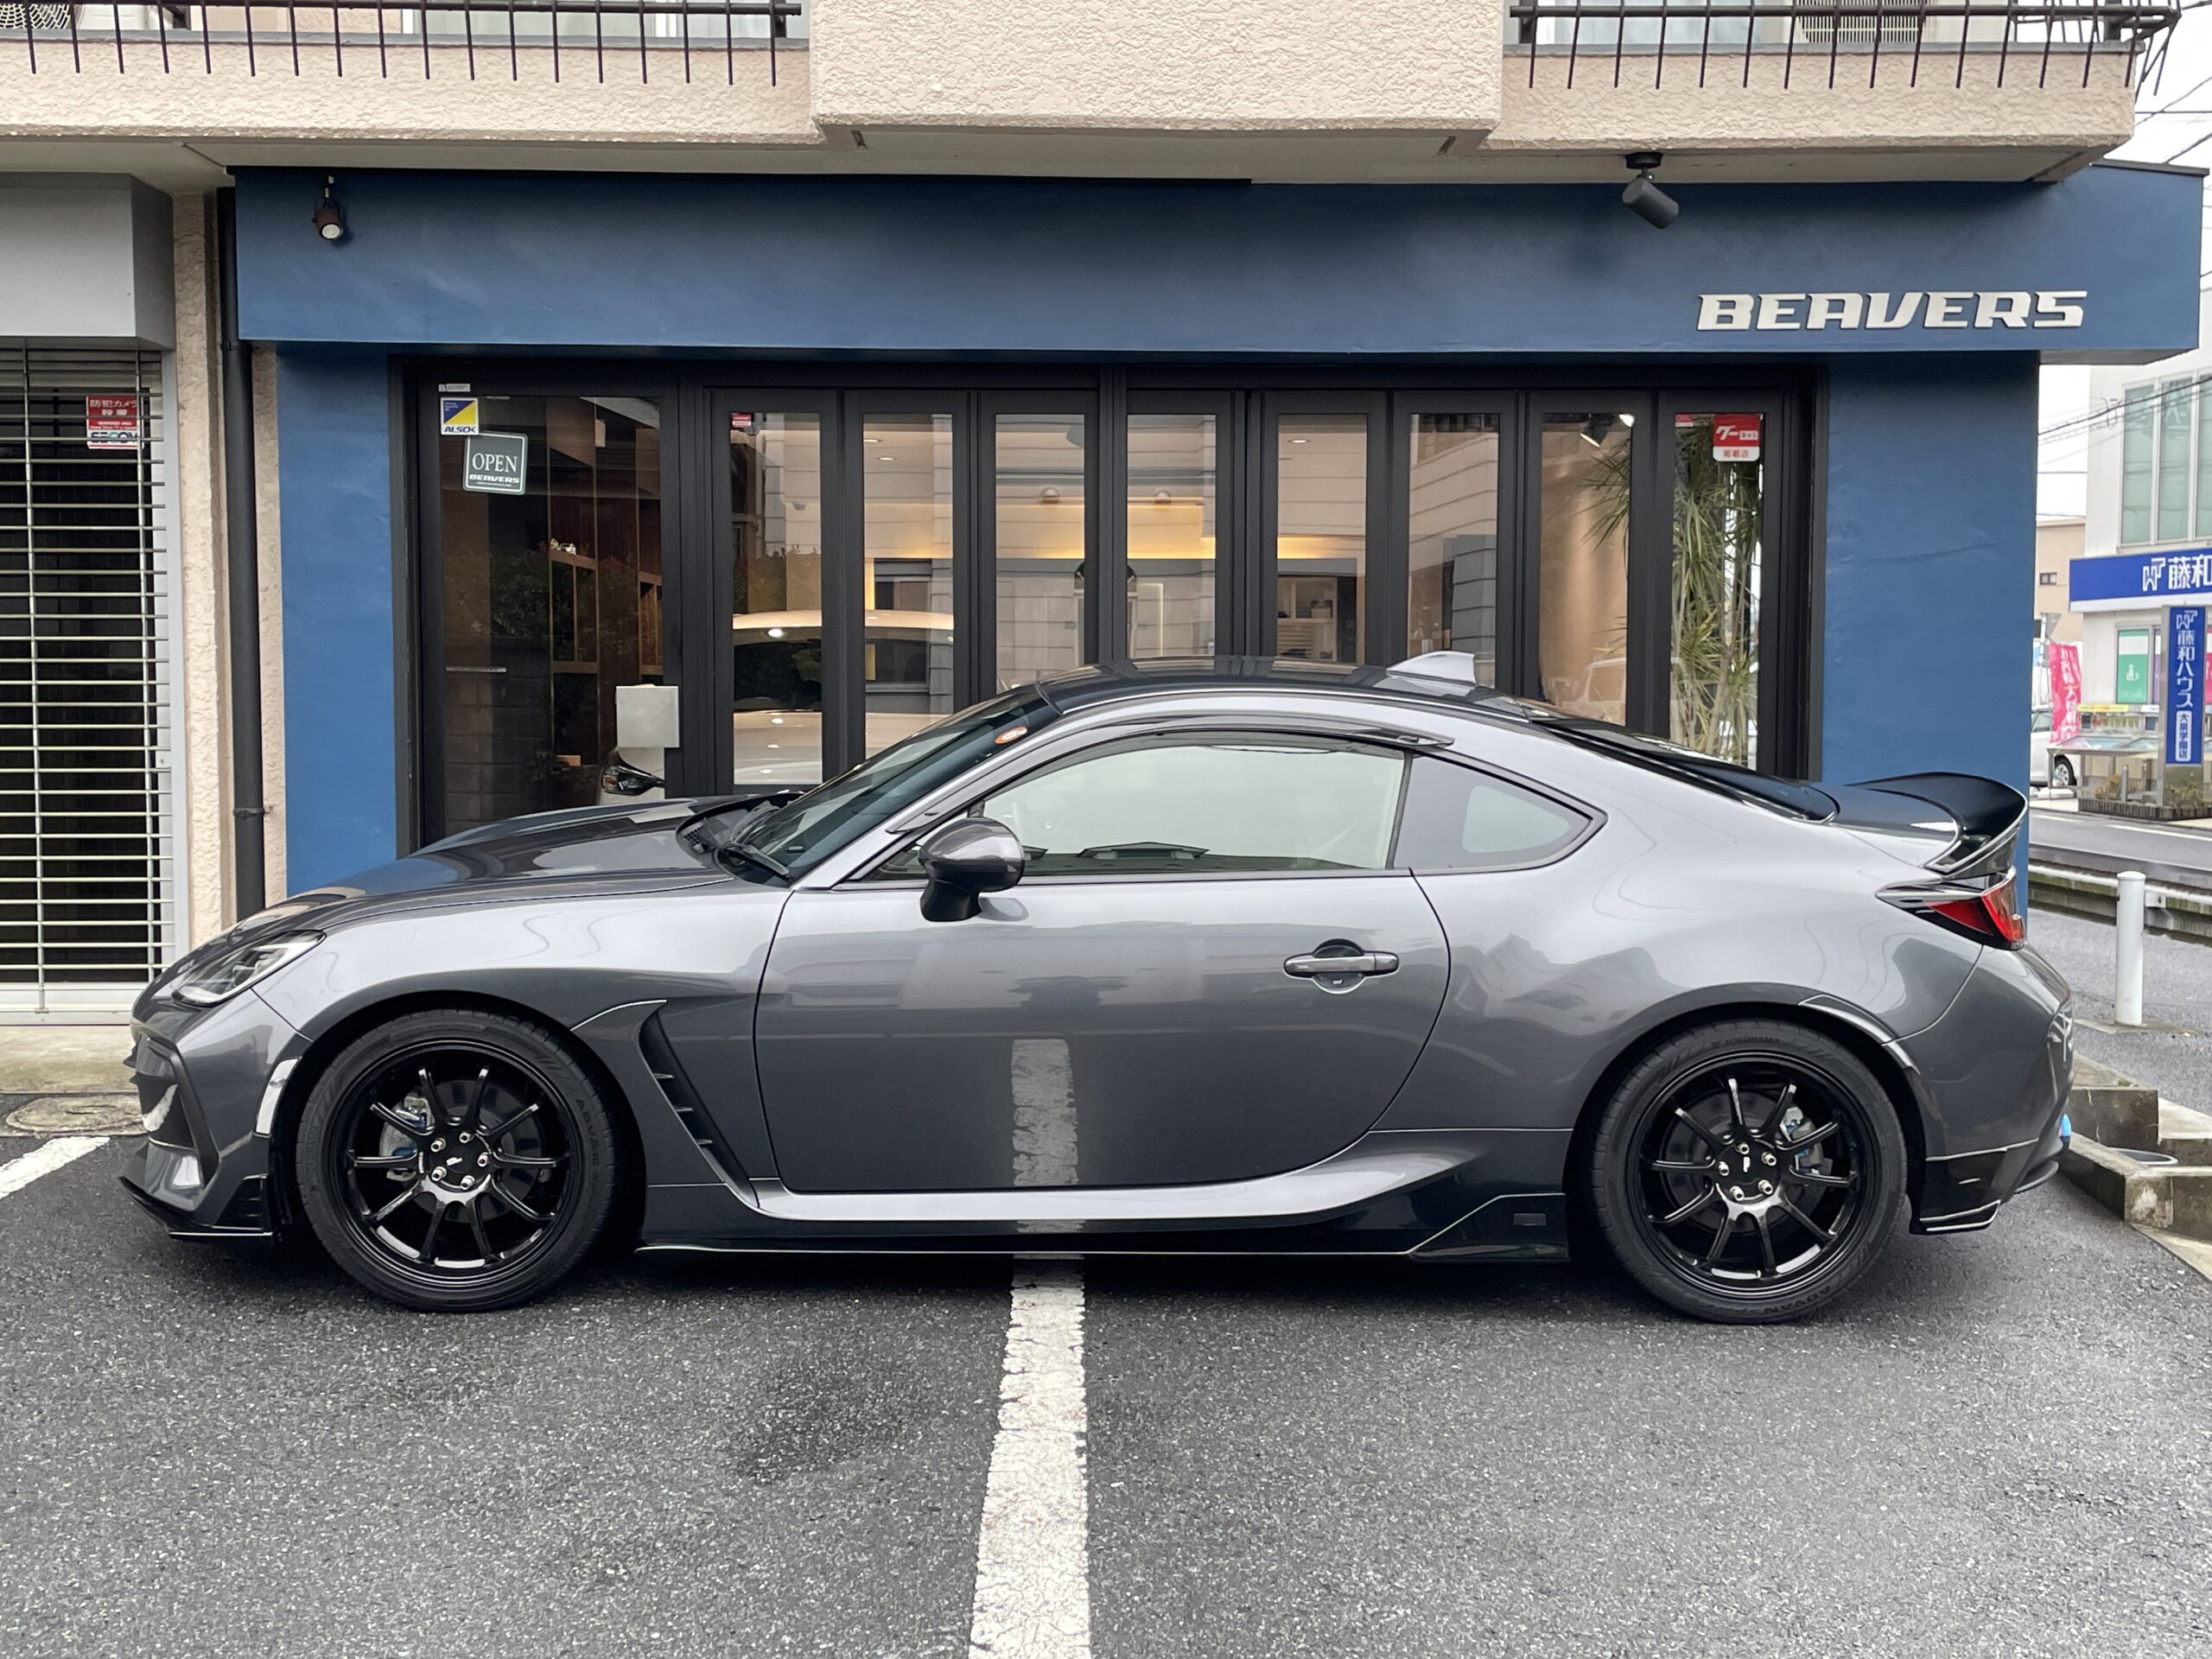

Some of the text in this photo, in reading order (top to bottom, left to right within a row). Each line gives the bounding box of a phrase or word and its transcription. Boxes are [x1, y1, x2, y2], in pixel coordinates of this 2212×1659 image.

[1697, 290, 2088, 331] BEAVERS
[472, 453, 518, 473] OPEN
[2176, 629, 2196, 708] 藤和ハウス
